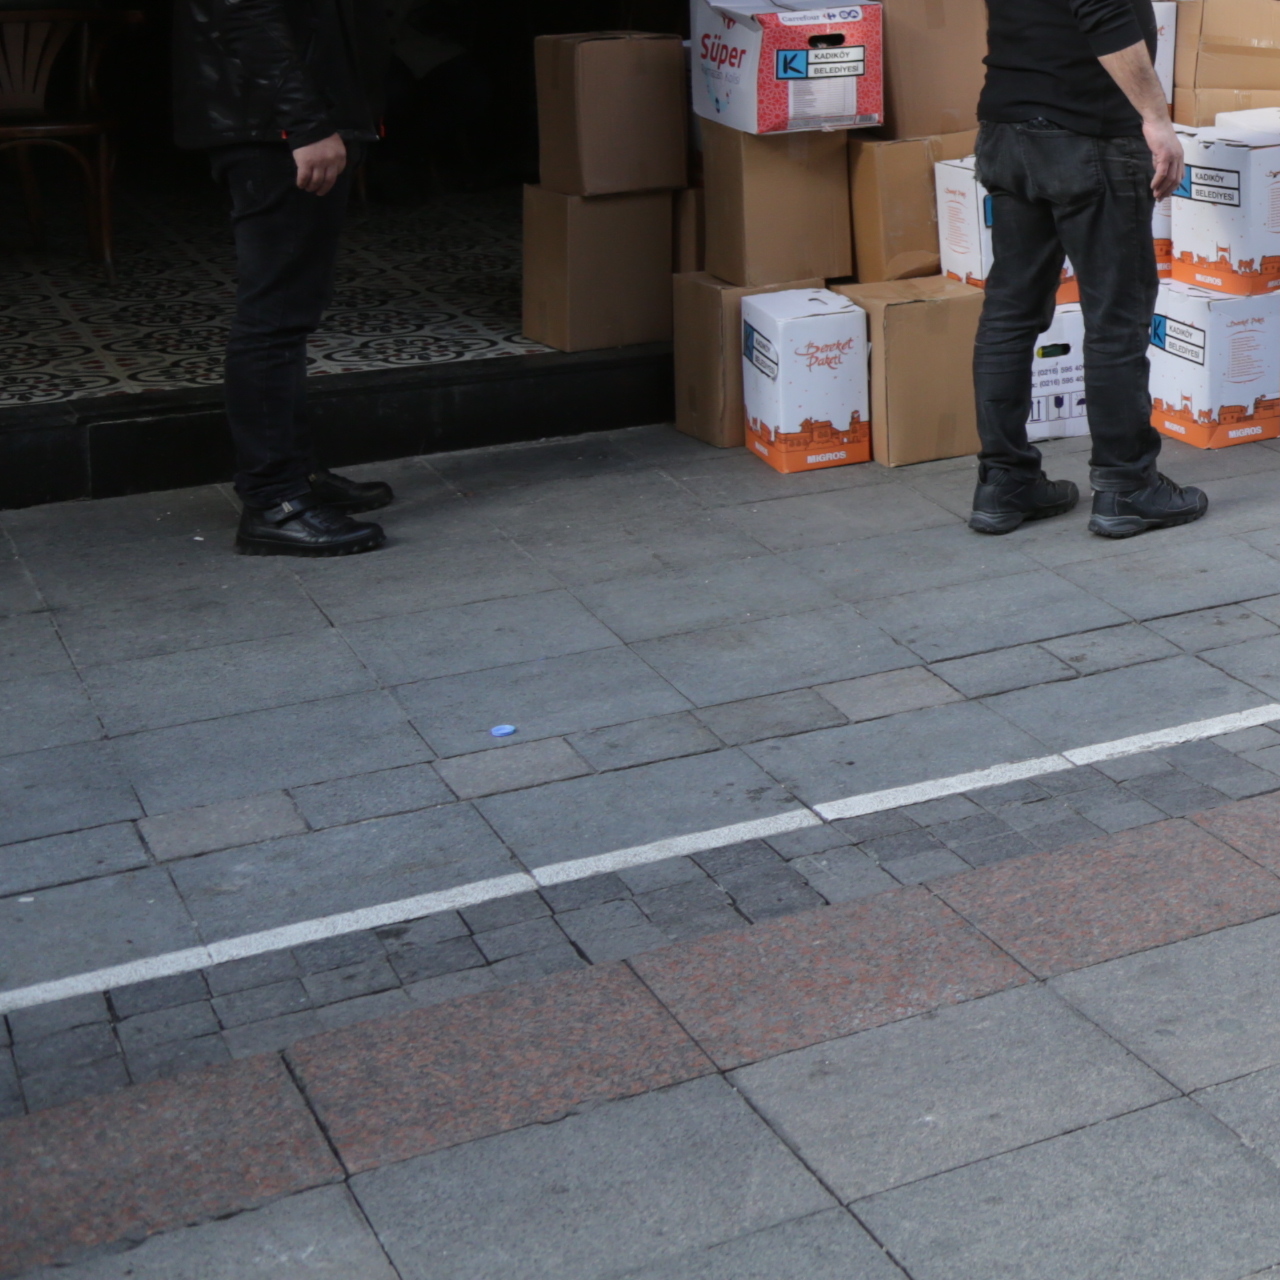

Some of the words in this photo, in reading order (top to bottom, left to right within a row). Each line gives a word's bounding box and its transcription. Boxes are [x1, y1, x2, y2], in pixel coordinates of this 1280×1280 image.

[782, 13, 820, 22] Carrefour
[701, 33, 747, 70] Süper
[814, 51, 851, 60] KADIKÖY
[813, 65, 860, 75] BELEDİYESİ
[1195, 172, 1224, 184] KADIKÖY
[1195, 188, 1235, 202] BELEDİYESİ
[1195, 273, 1223, 286] MIGROS
[1168, 324, 1193, 339] KADIKÖY
[794, 337, 854, 357] Bereket
[1168, 340, 1200, 359] BELEDİYESİ
[806, 354, 843, 372] Paketi
[1037, 367, 1058, 377] (0216)
[1061, 365, 1073, 373] 595
[1040, 379, 1060, 389] (0216)
[1228, 426, 1262, 438] MIGROS
[806, 451, 847, 464] MIGROS
